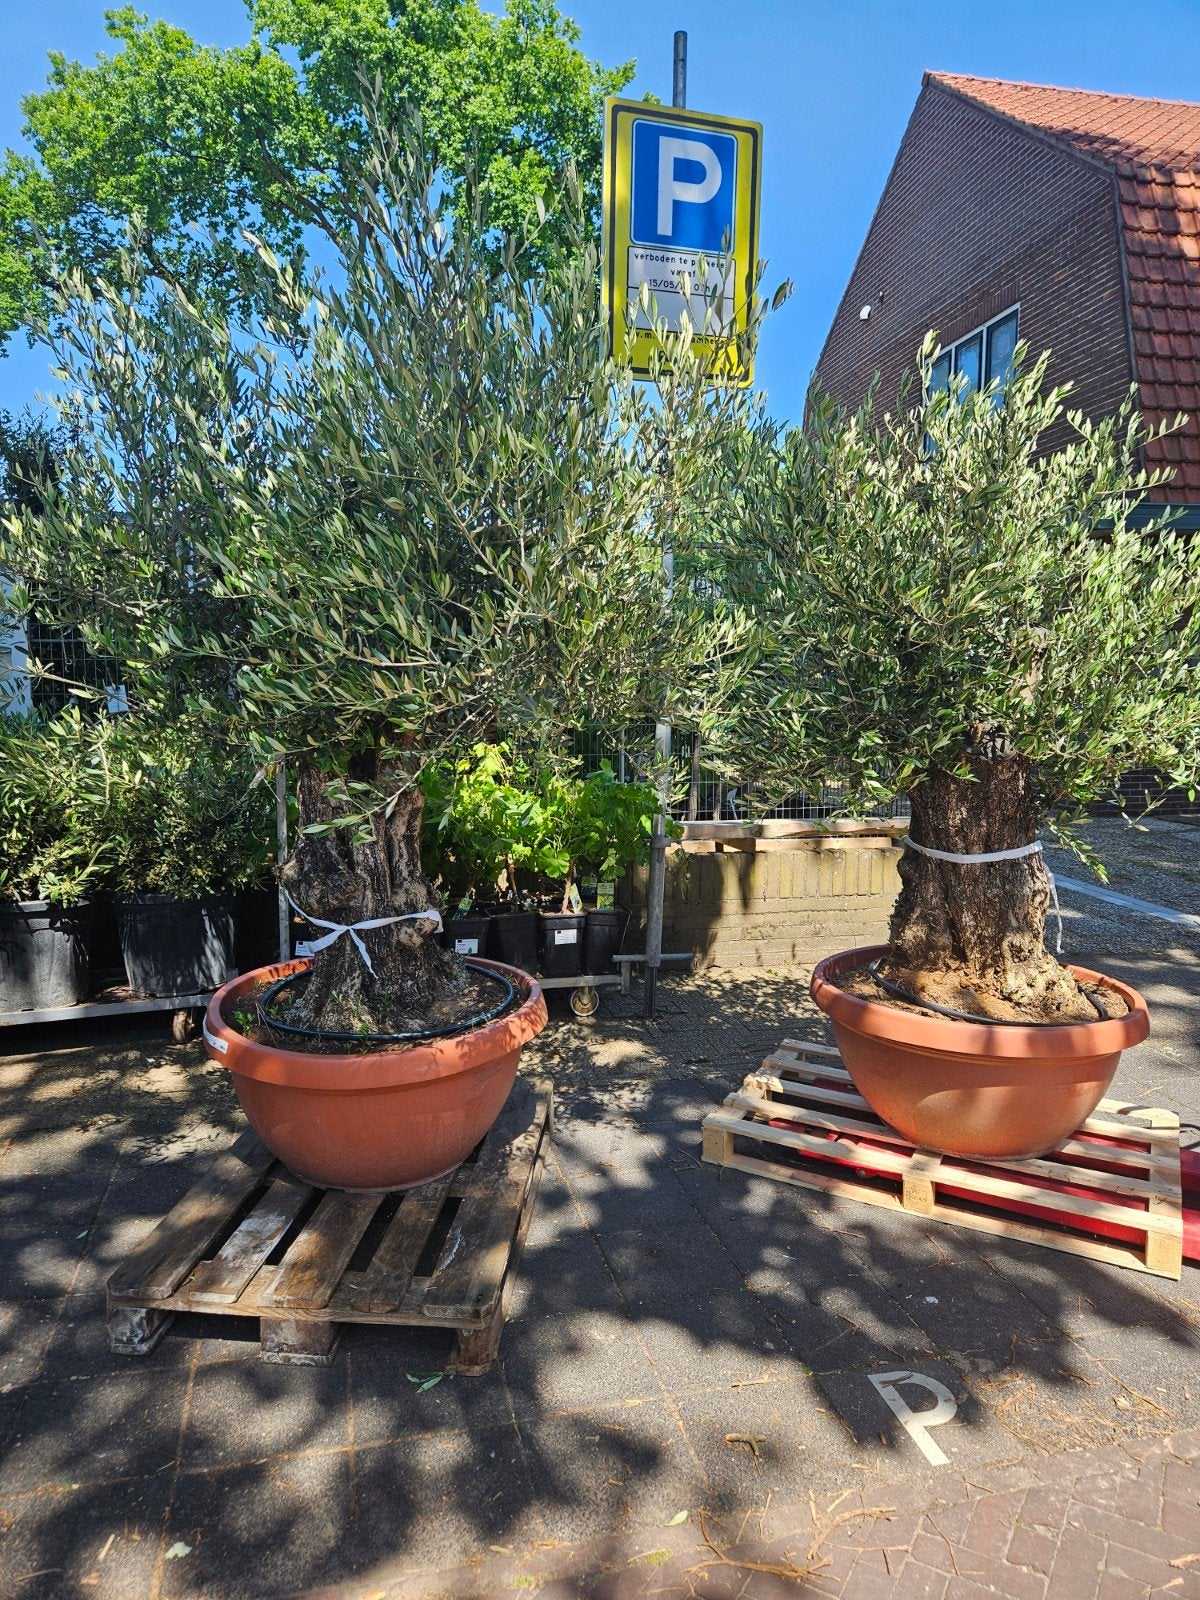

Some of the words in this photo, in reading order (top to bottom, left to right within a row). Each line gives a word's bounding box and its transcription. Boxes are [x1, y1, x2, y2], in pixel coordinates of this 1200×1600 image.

[657, 135, 723, 237] P
[634, 252, 676, 264] verboden
[679, 256, 688, 265] te
[691, 258, 727, 269] pkee
[670, 269, 696, 278] vaaf
[649, 278, 690, 291] 15/05/
[867, 1370, 959, 1468] P
